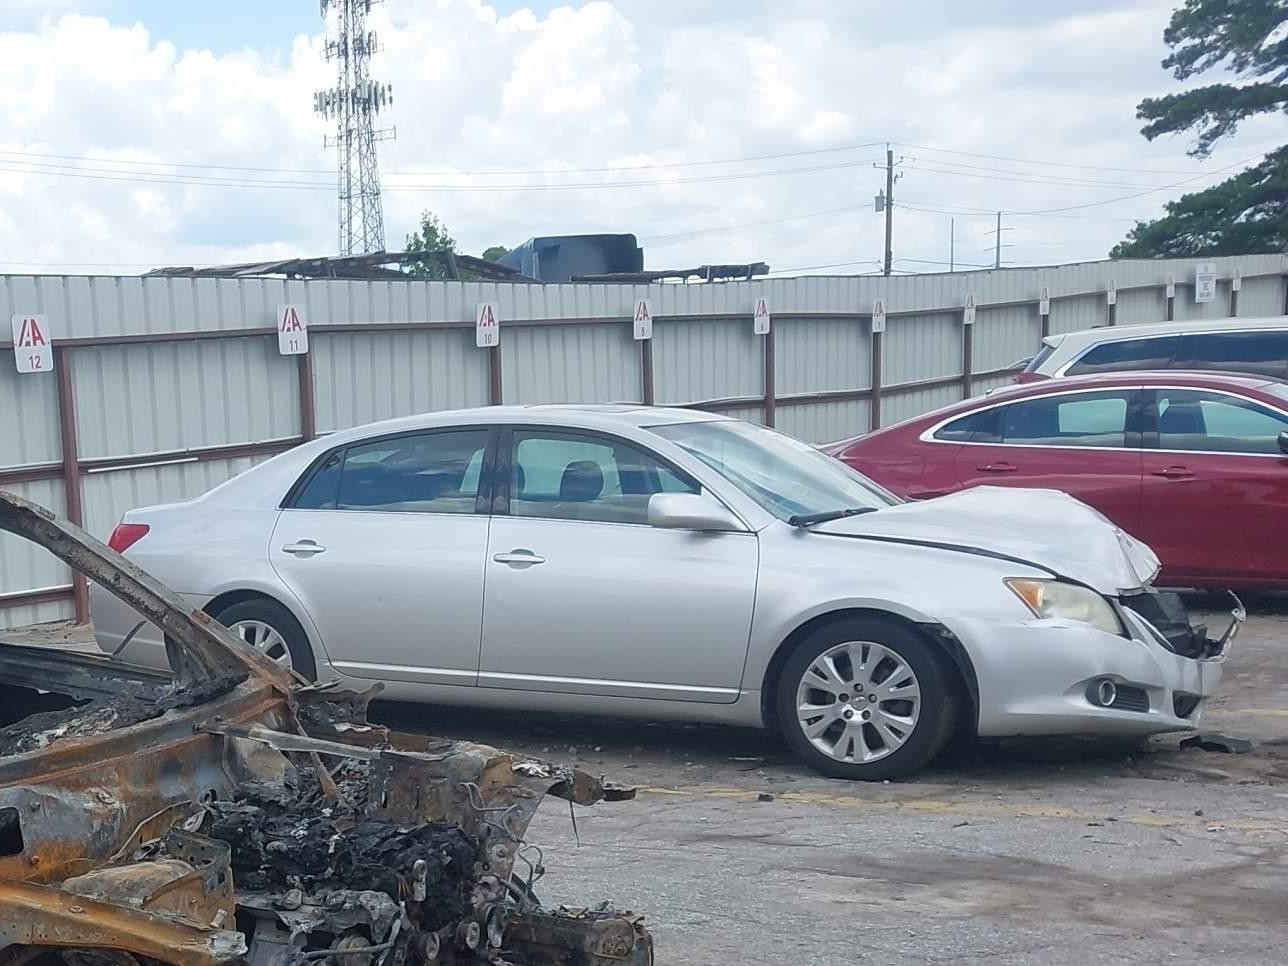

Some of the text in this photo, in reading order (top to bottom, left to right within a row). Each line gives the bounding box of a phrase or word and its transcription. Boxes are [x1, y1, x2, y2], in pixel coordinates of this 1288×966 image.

[288, 339, 298, 352] 11
[484, 333, 492, 345] 10
[28, 355, 42, 369] 12
